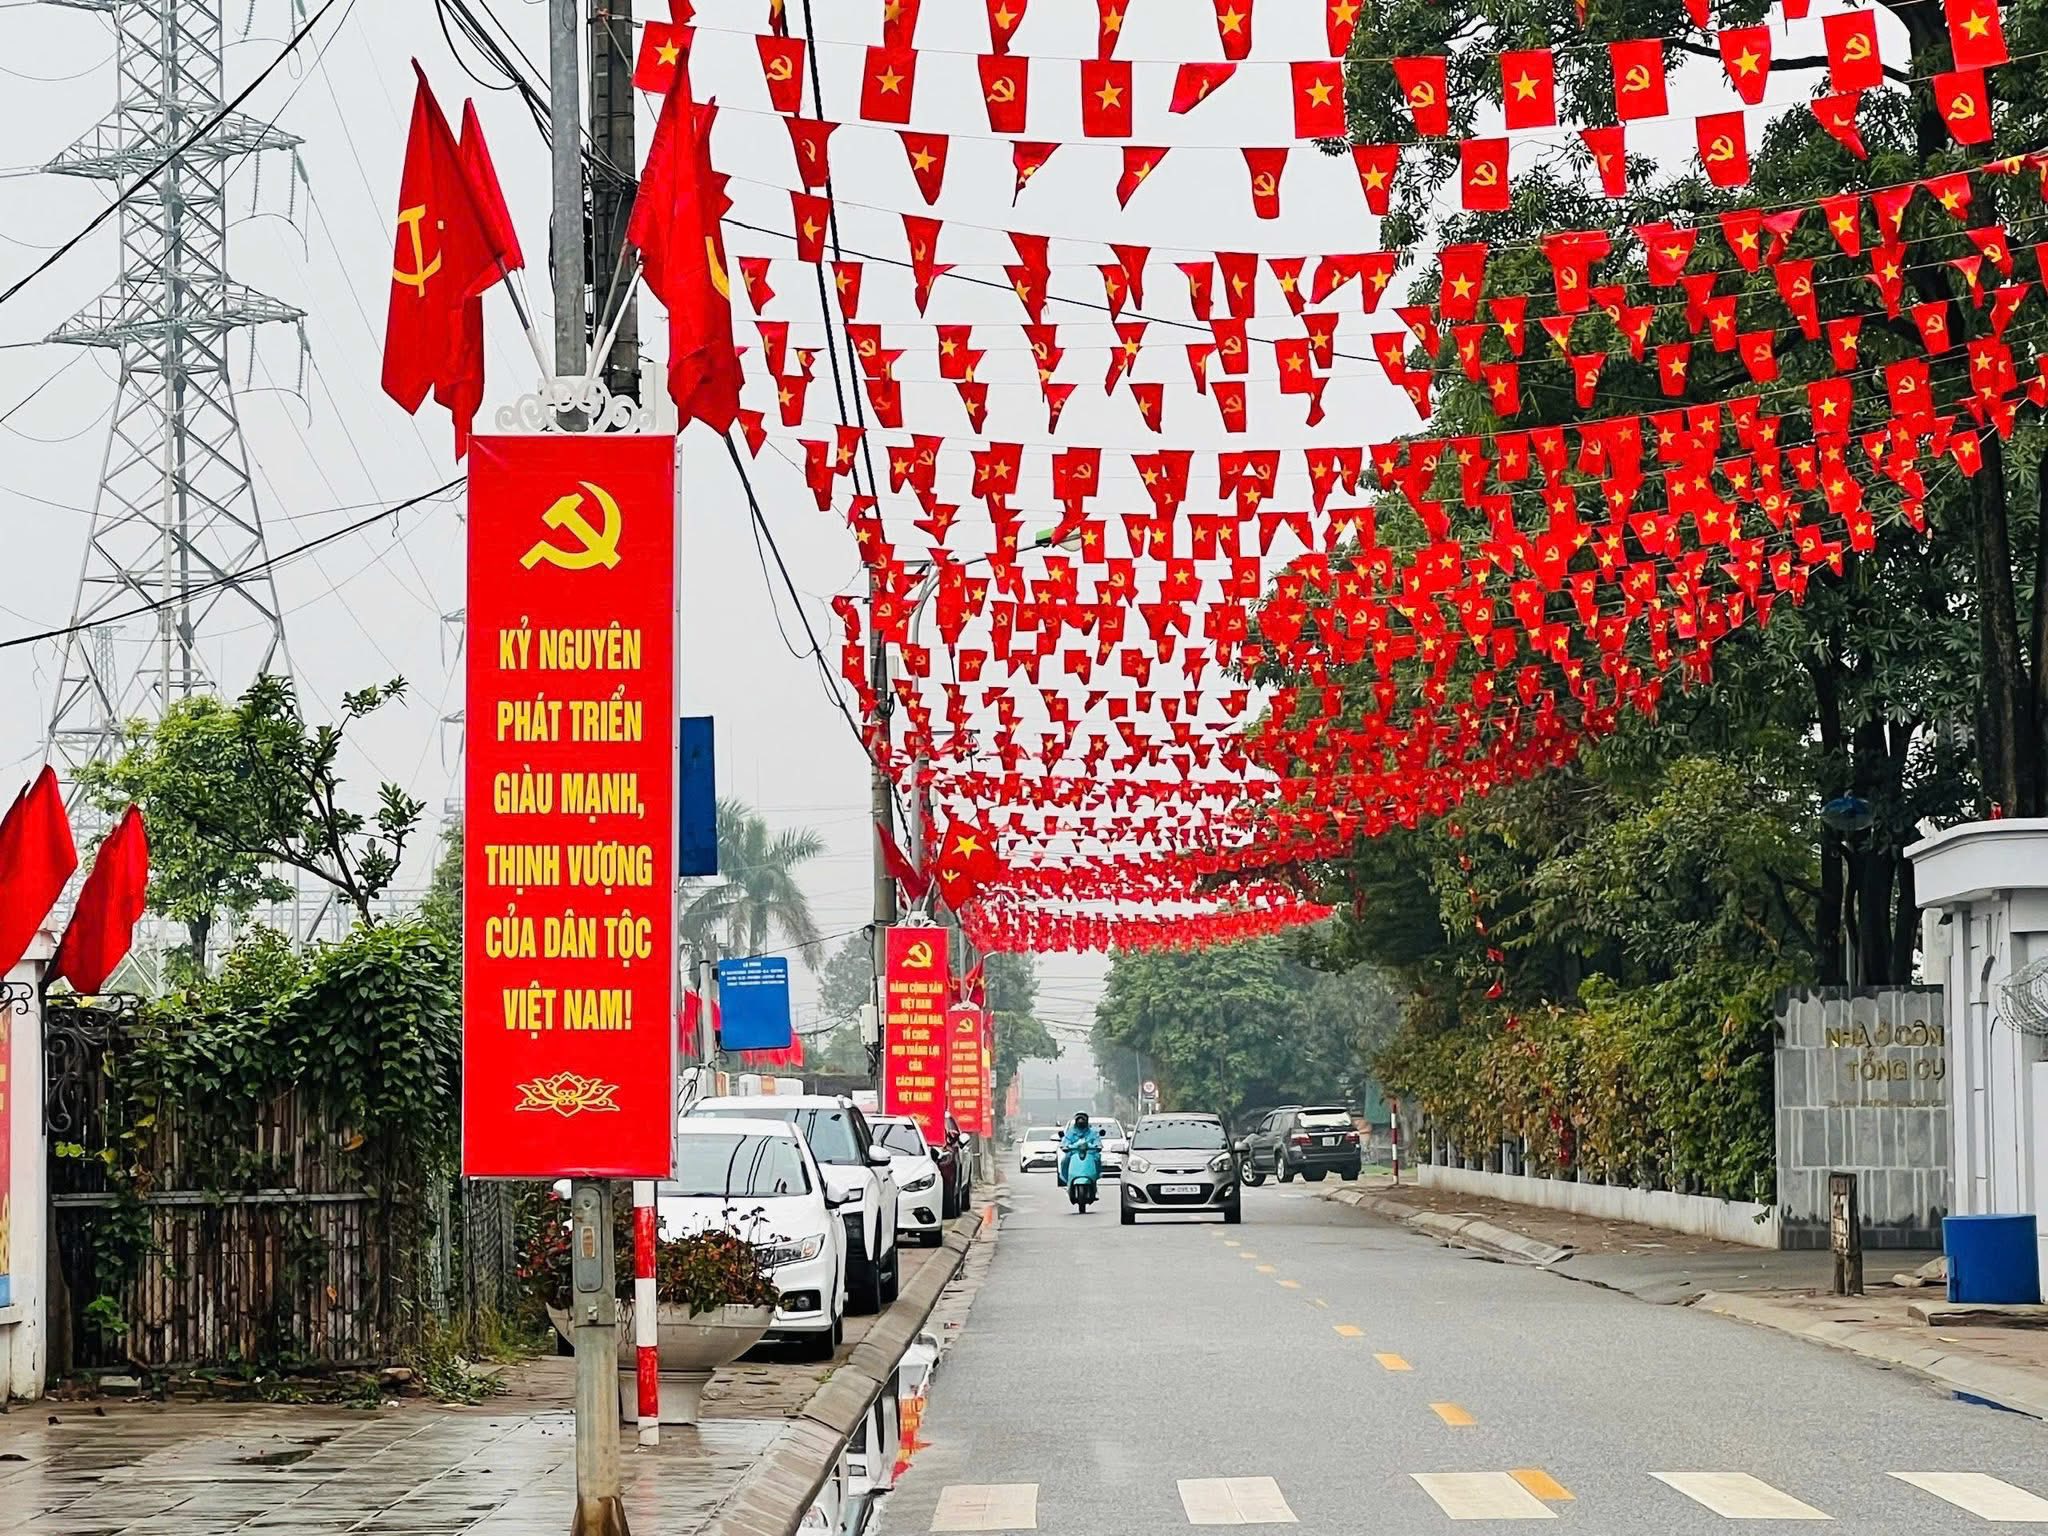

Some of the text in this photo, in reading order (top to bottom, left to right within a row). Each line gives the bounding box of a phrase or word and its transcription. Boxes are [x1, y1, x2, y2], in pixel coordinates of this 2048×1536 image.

[500, 616, 640, 670] KỶ NGUYÊN
[498, 684, 641, 741] PHÁT TRIỂN
[494, 764, 644, 823] GIÀU MẠNH,
[485, 841, 652, 895] THỊNH VƯỢNG
[486, 903, 651, 967] CỦA DÂN TỘC
[503, 981, 631, 1039] VIỆT NAM!
[1825, 1021, 1872, 1048] NHÀ
[1874, 1017, 1891, 1047] Ở
[1846, 1050, 1908, 1081] TỔNG
